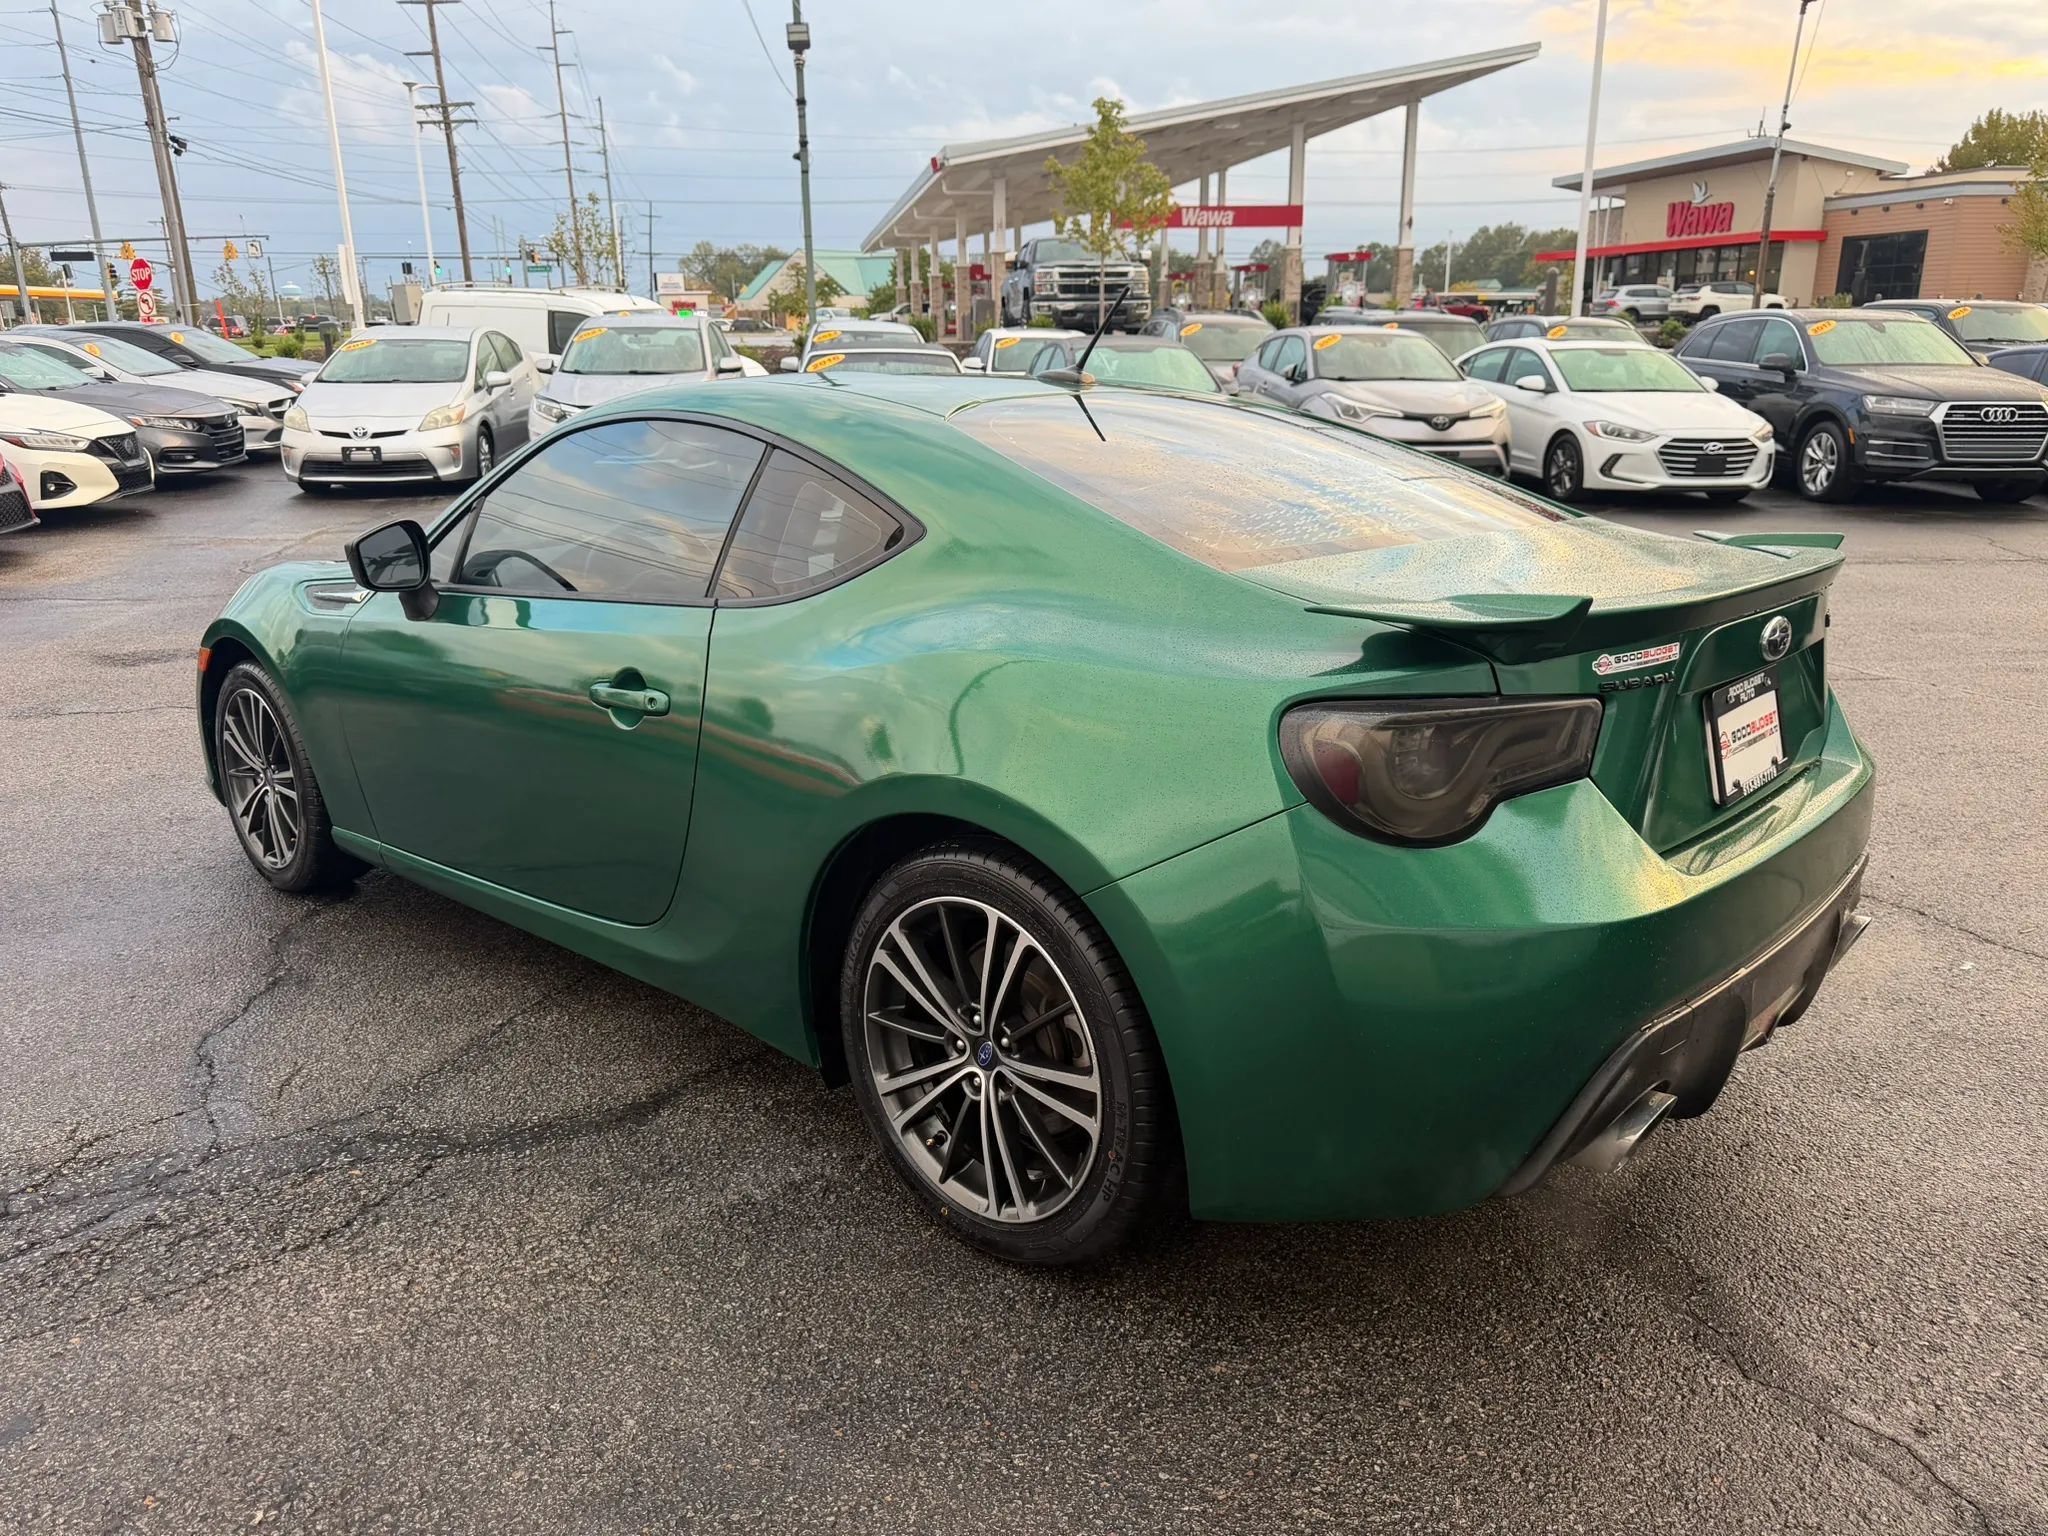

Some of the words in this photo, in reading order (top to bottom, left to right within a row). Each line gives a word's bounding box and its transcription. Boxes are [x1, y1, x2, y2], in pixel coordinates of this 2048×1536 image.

[1181, 207, 1235, 226] Wawa
[1667, 201, 1735, 238] Wawa
[132, 267, 151, 281] STOP
[1599, 671, 1675, 692] SUBARU
[1102, 1178, 1117, 1202] HP
